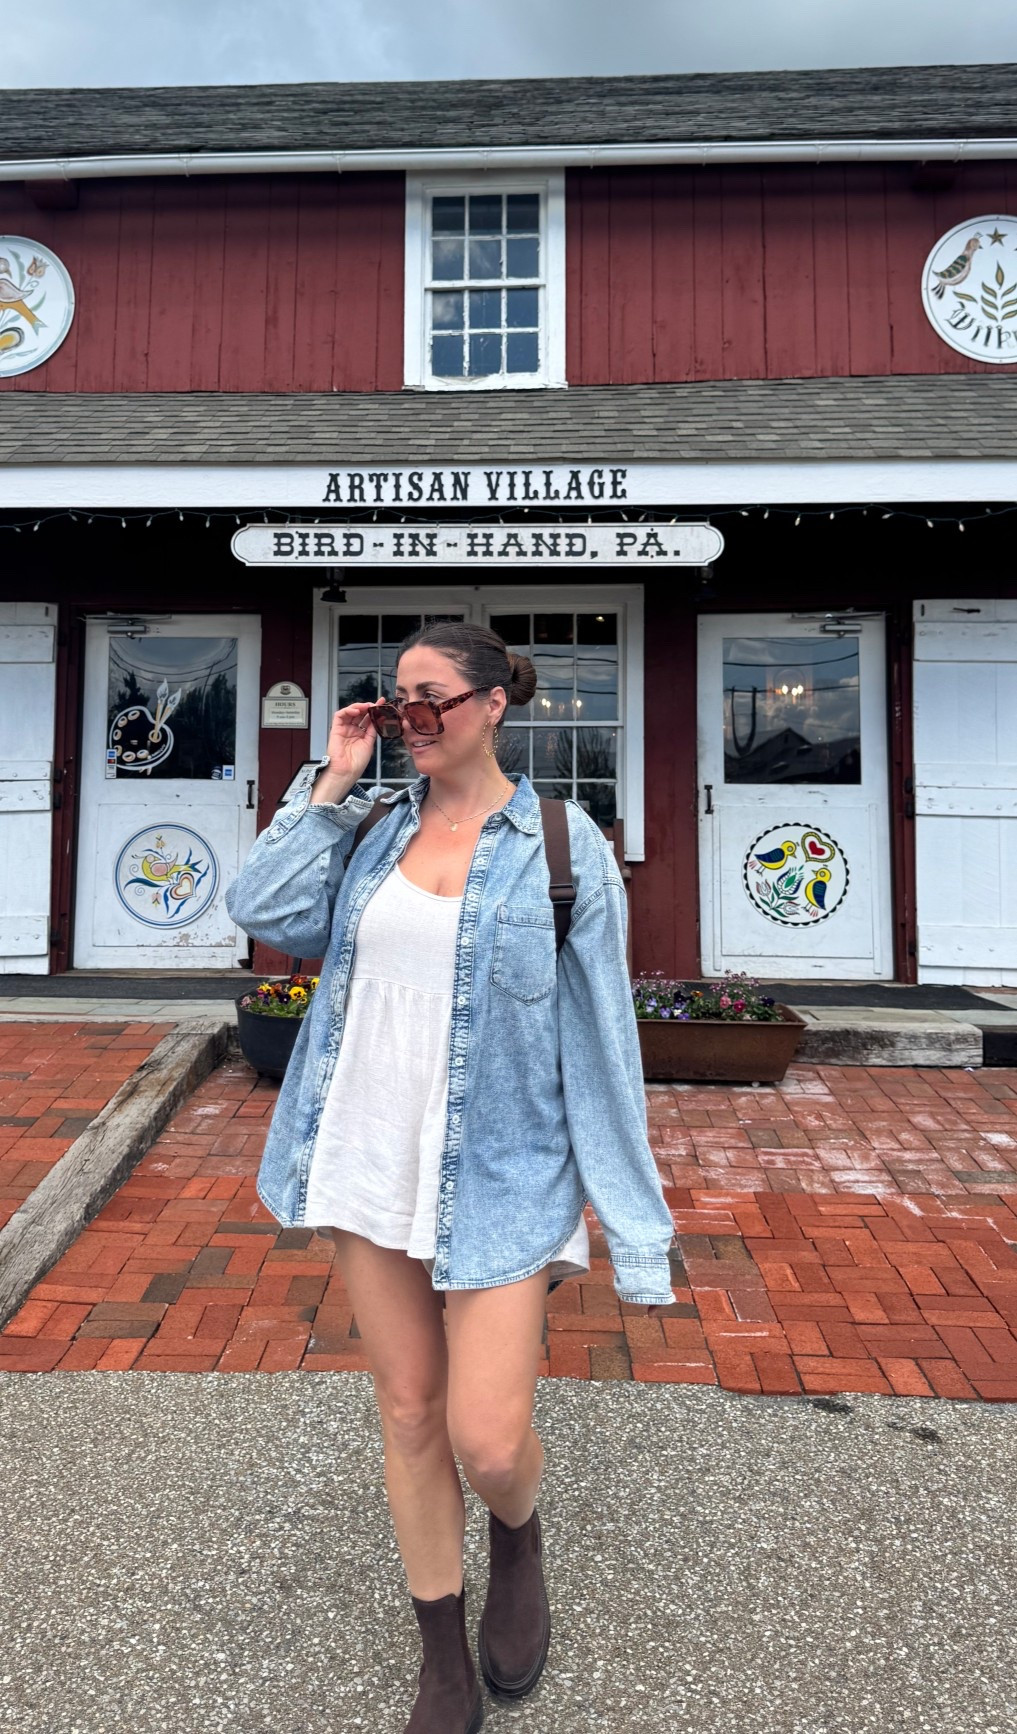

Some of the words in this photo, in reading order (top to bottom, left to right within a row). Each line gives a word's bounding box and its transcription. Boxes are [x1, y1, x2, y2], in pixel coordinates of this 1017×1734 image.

[322, 471, 471, 503] ARTISAN
[483, 468, 628, 501] VILLAGE
[273, 531, 598, 559] BIRD-IN-HAND,
[615, 531, 682, 558] PA.
